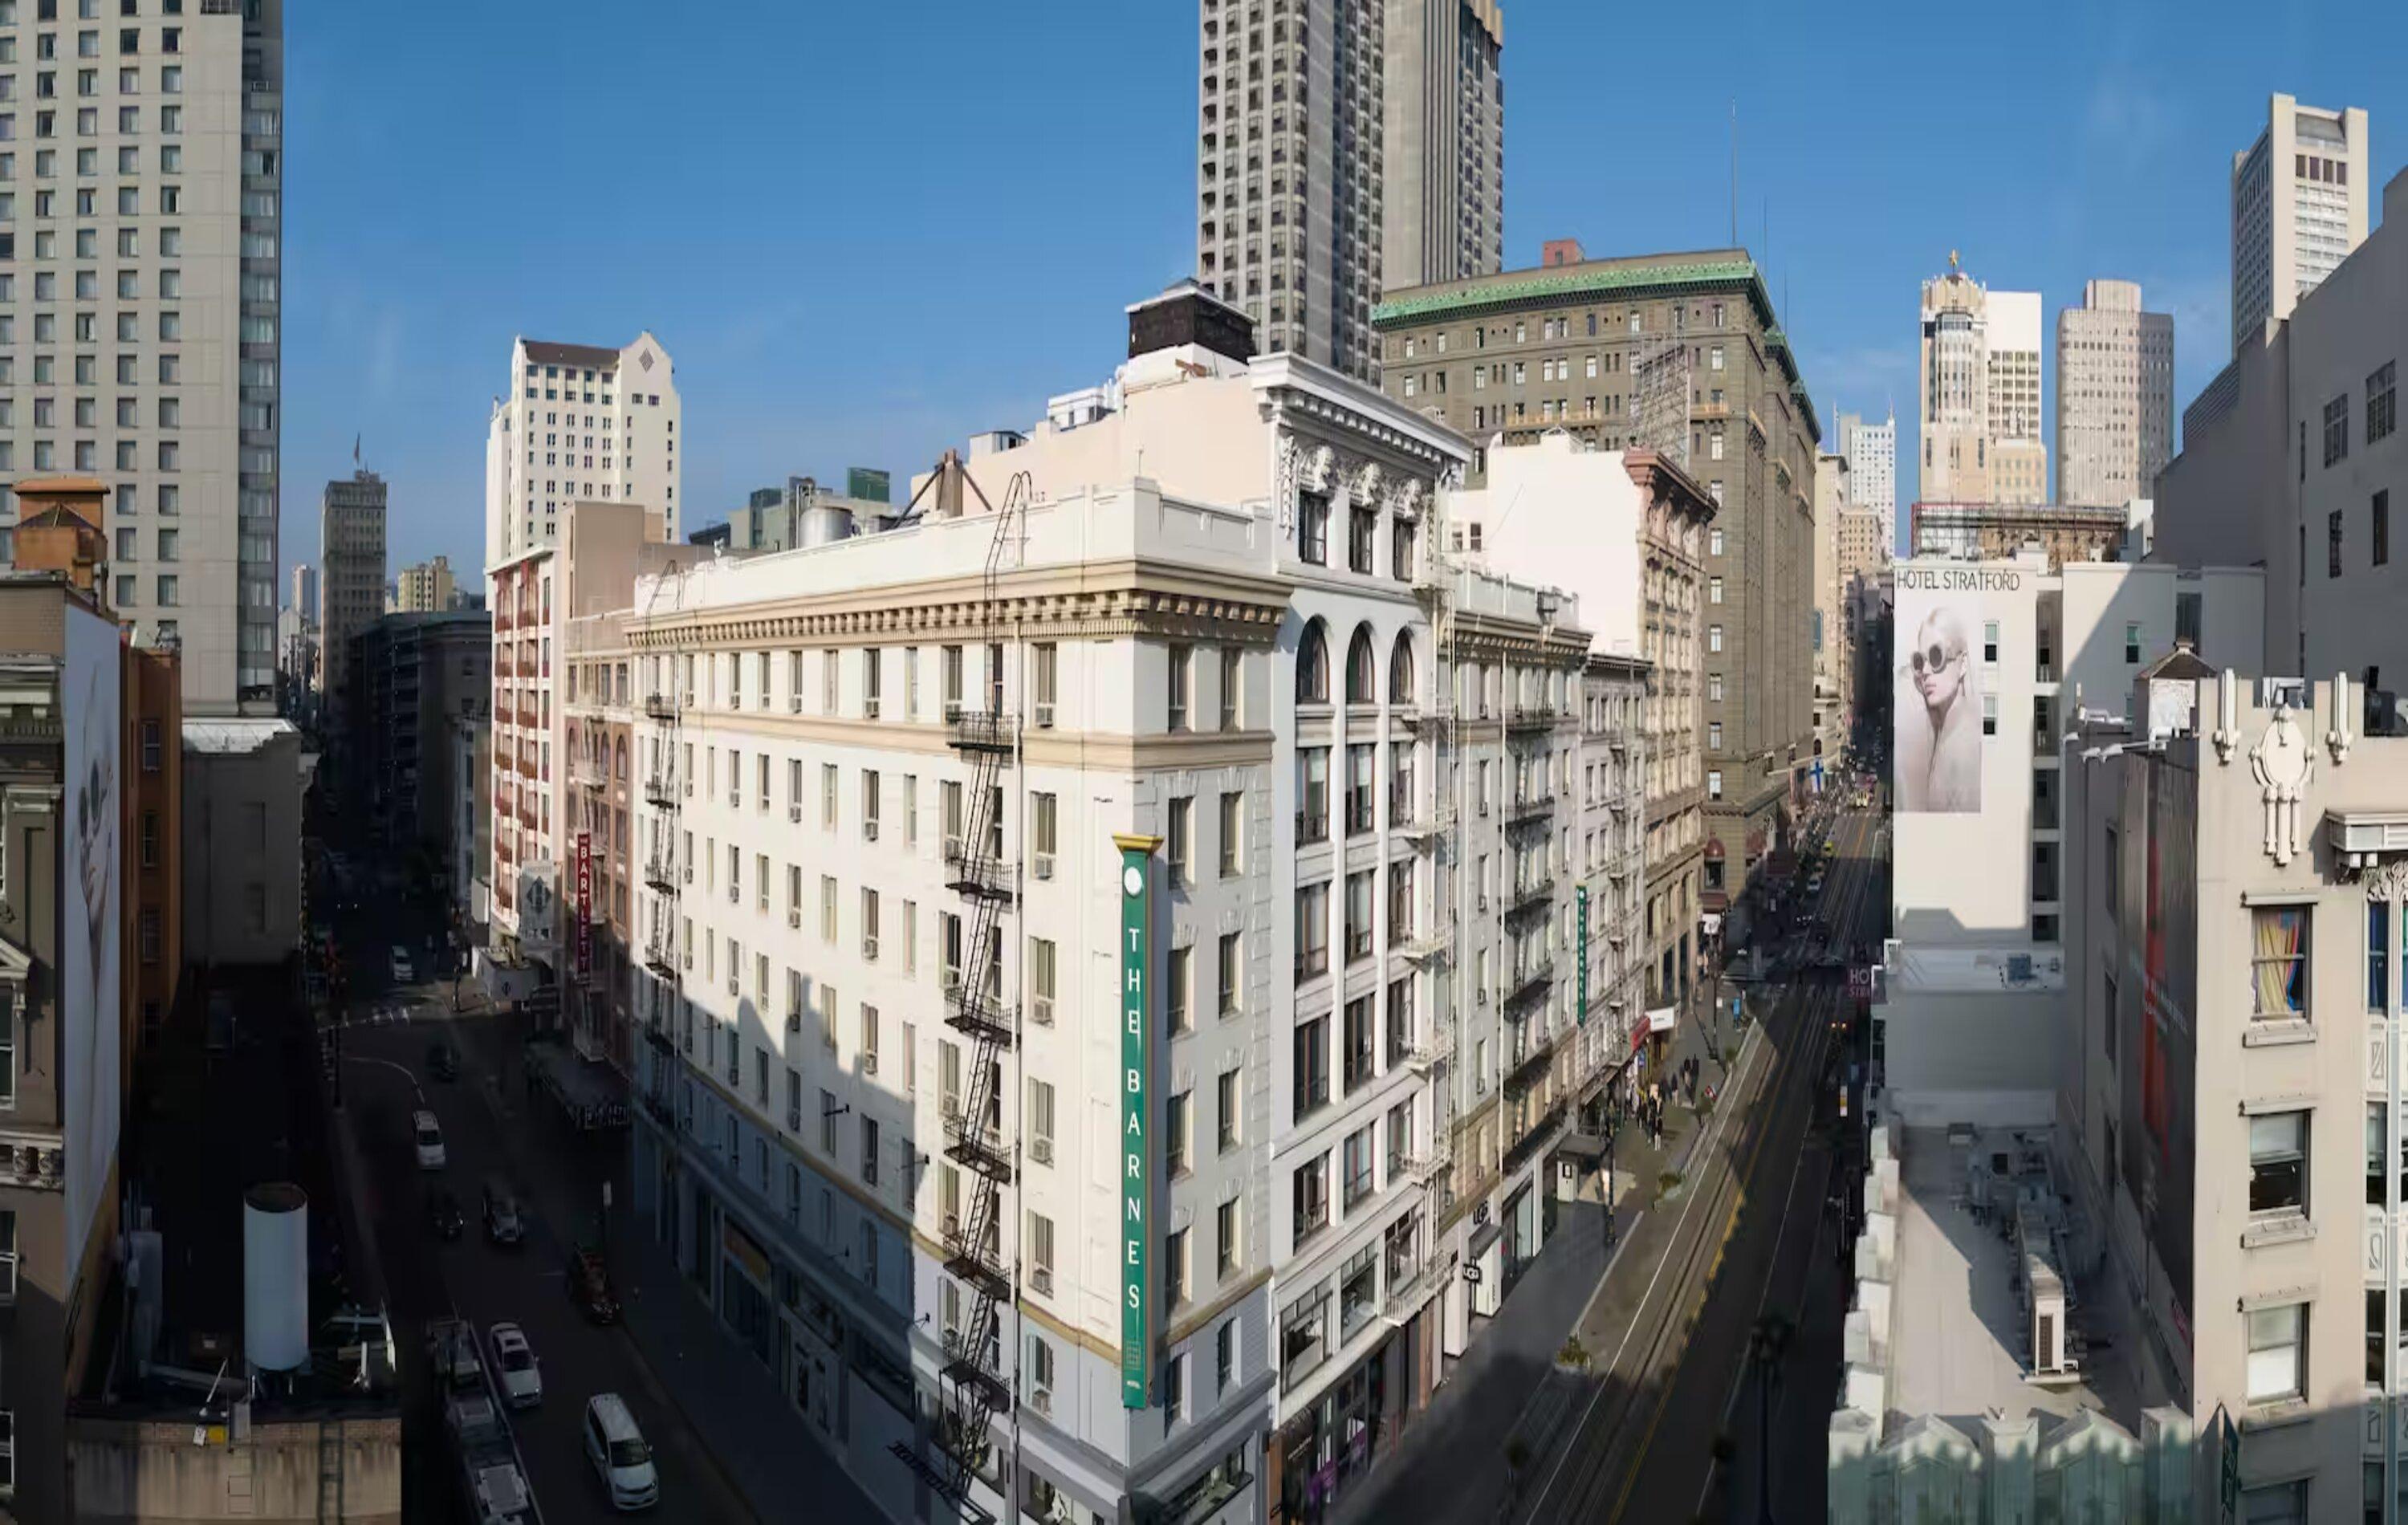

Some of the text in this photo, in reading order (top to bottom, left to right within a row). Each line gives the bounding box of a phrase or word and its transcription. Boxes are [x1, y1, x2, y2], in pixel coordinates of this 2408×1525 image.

[1897, 570, 2020, 592] HOTEL STRATFORD
[580, 847, 588, 970] BARTLETT
[1127, 927, 1141, 1308] THE BARNES
